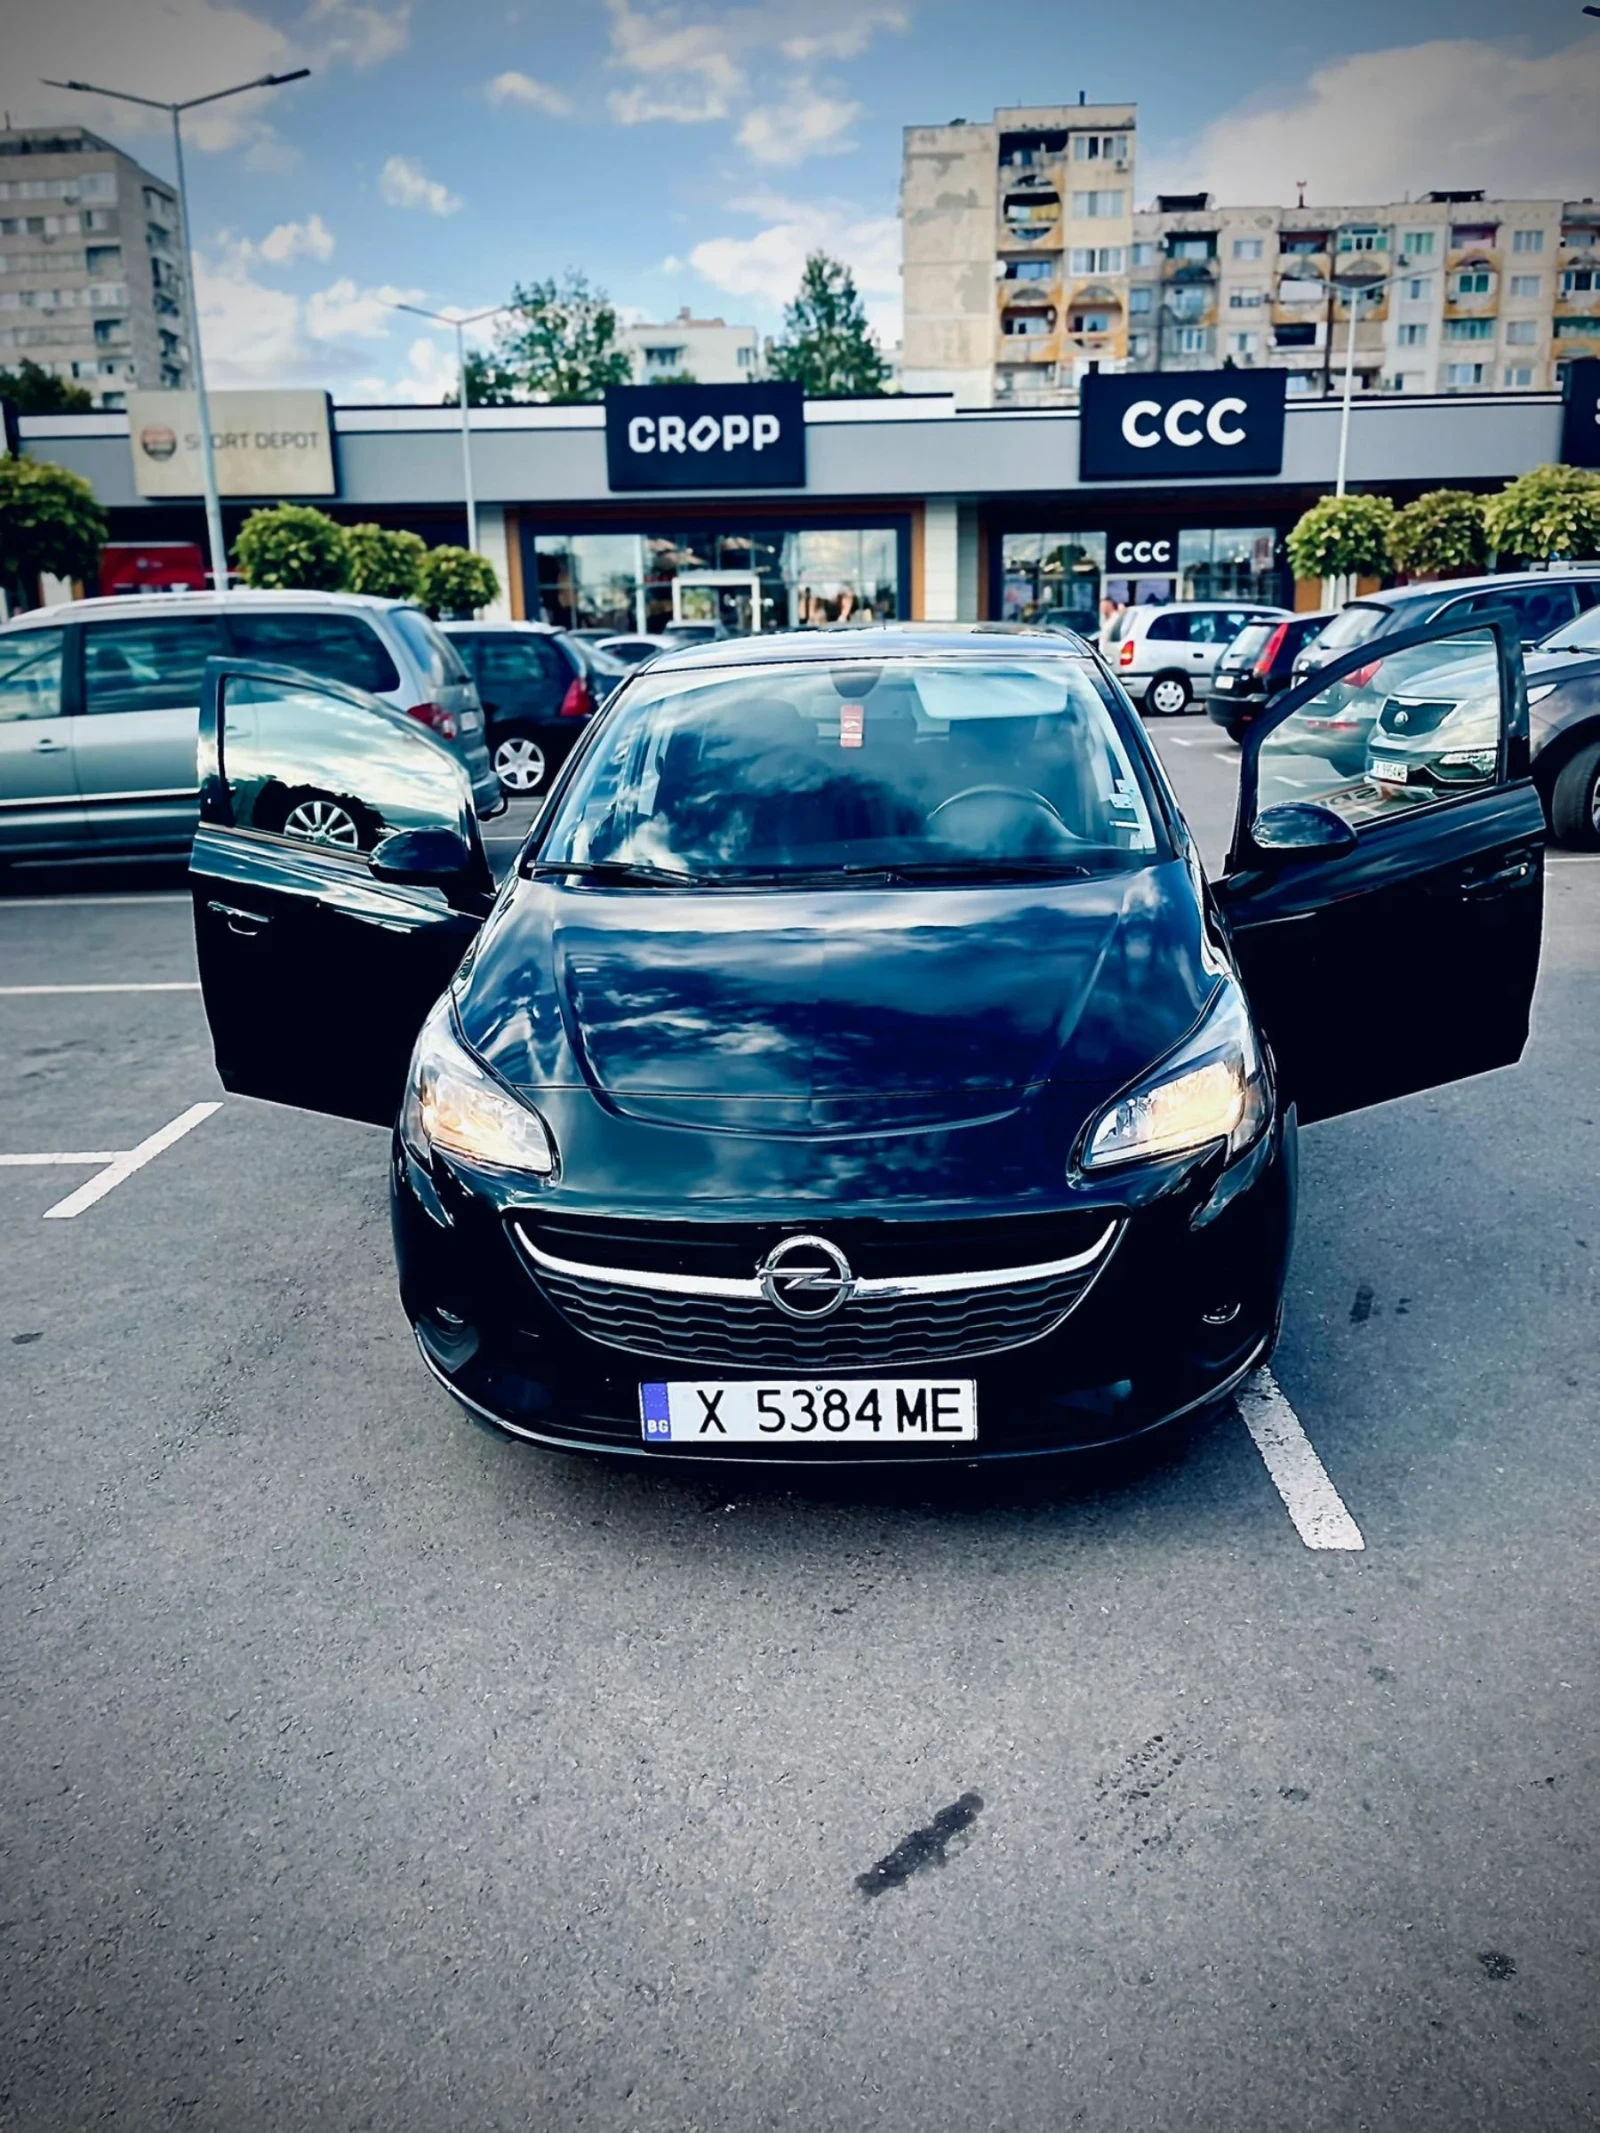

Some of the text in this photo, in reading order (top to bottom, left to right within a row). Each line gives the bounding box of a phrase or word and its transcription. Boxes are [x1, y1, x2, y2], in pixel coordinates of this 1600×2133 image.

[628, 414, 781, 453] CROPP
[1121, 397, 1247, 449] CCC
[183, 430, 320, 451] SORT DEPOT
[1115, 540, 1171, 564] CCC
[647, 1419, 669, 1434] BG
[696, 1388, 963, 1434] X 5384 ME
